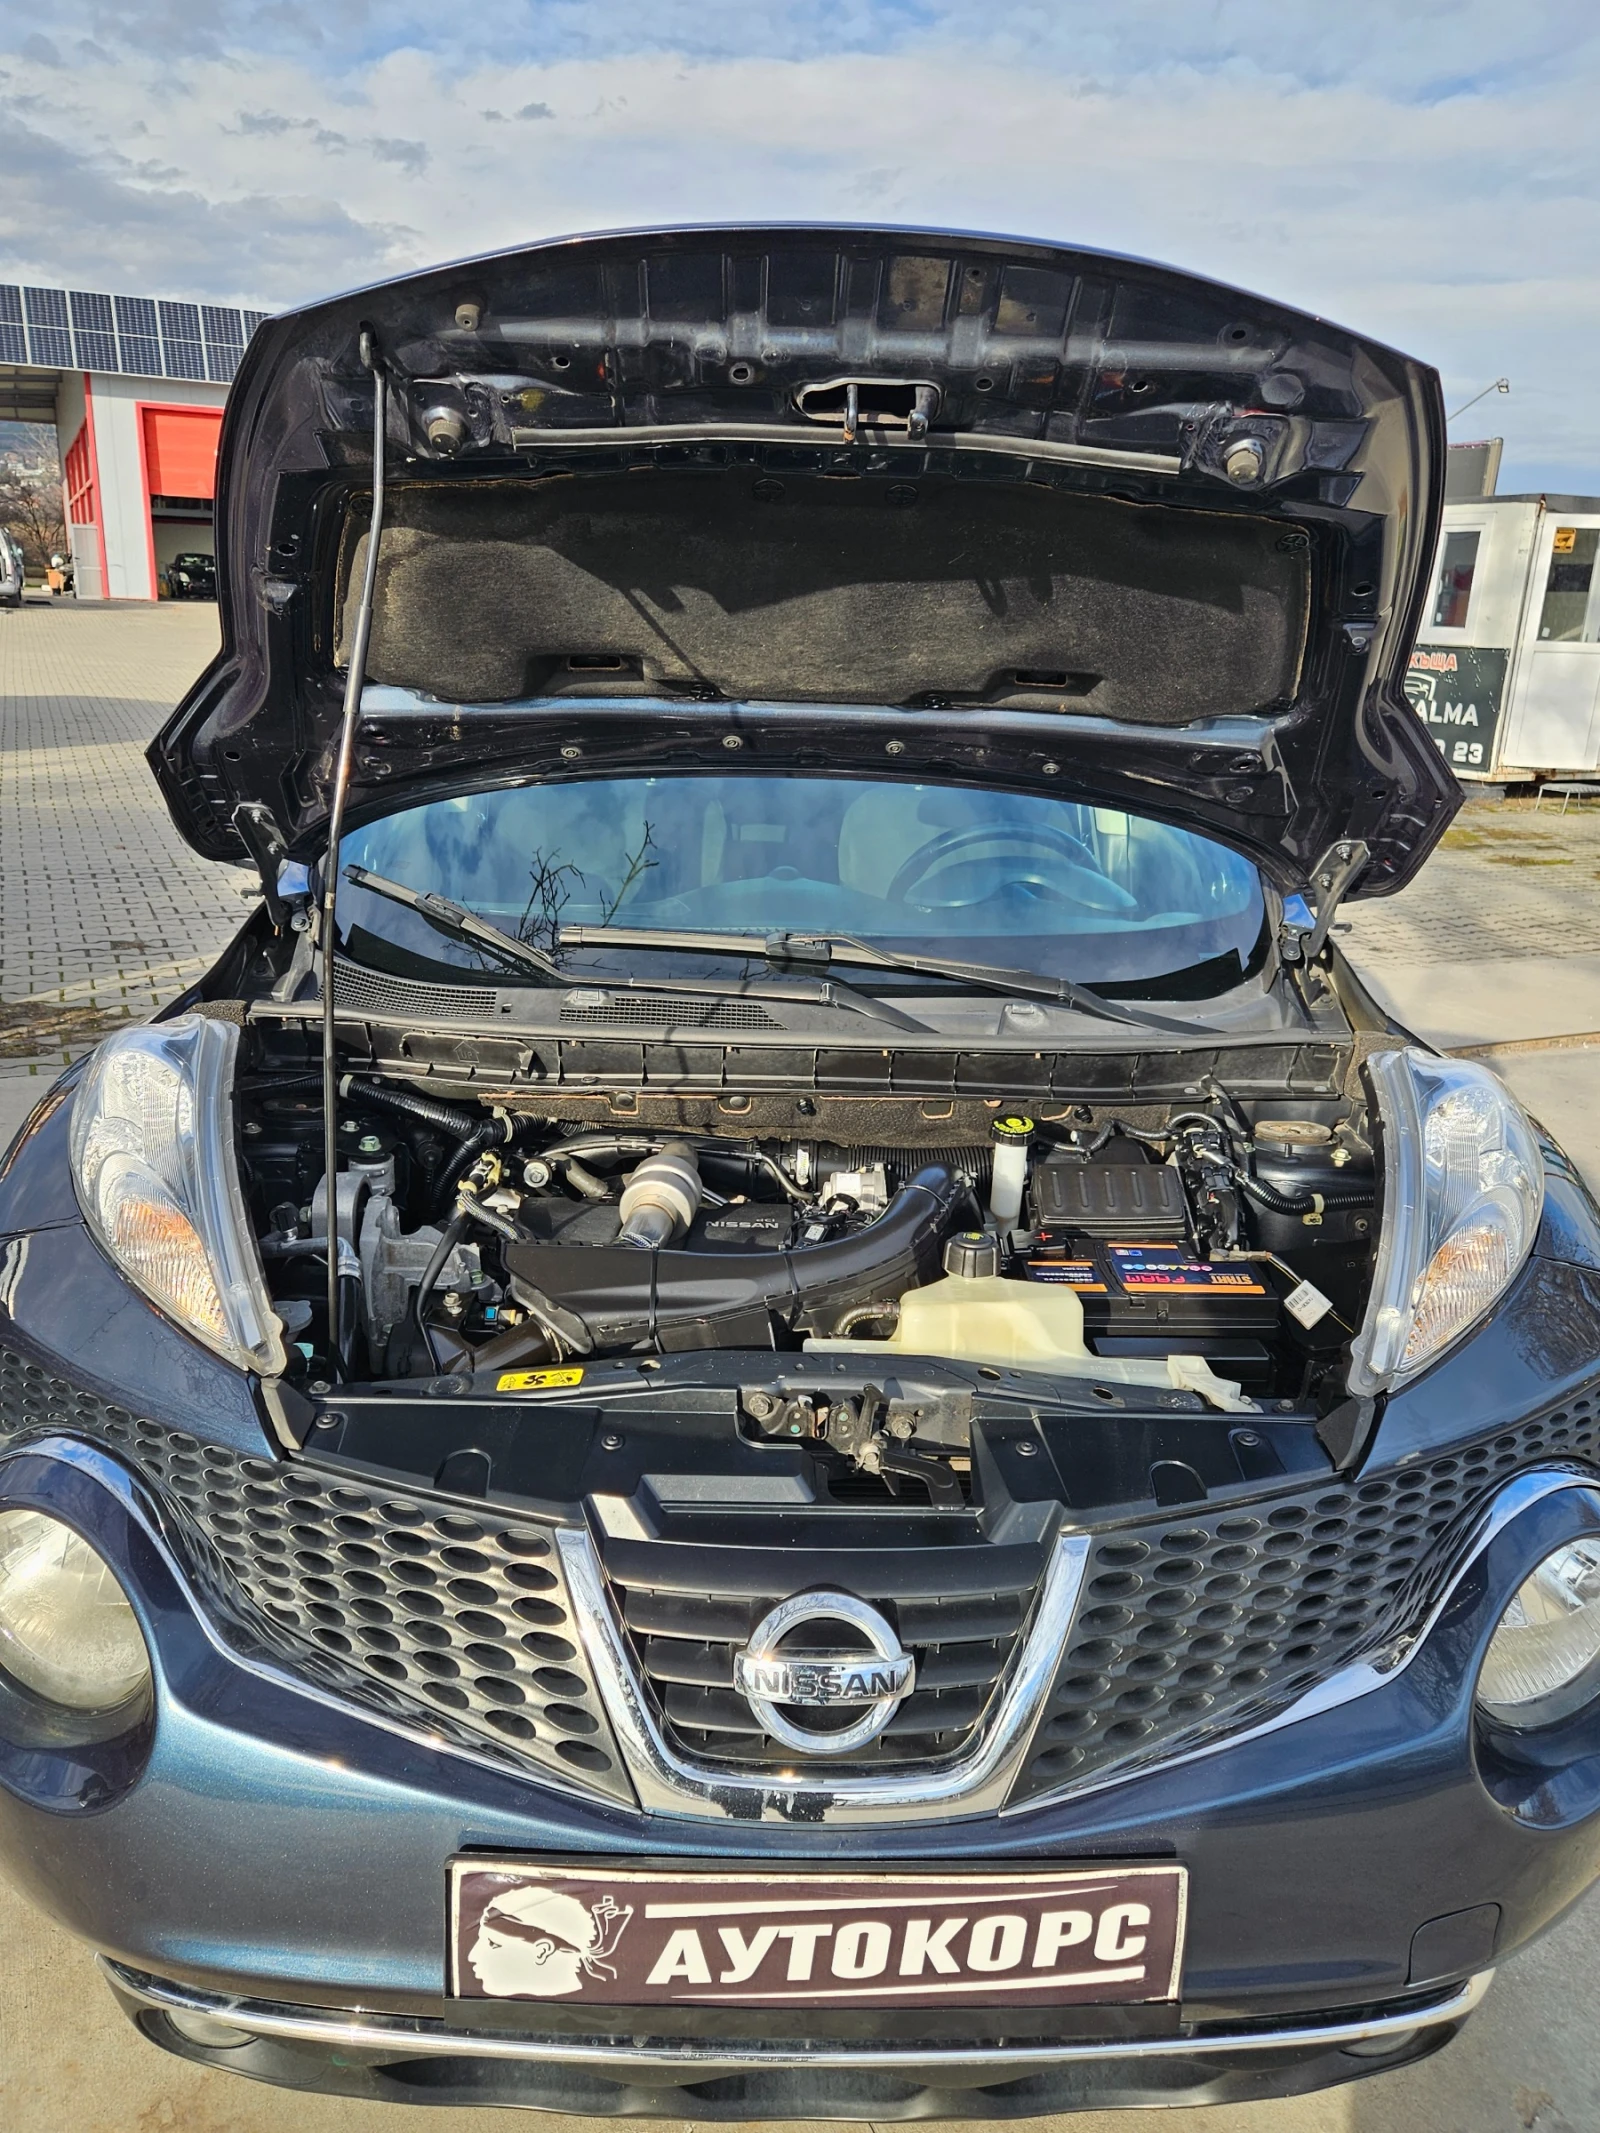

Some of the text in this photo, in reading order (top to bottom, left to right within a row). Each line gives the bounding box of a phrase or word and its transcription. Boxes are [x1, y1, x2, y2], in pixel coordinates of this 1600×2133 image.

[1409, 698, 1479, 727] ALMA
[1452, 741, 1484, 764] 23
[706, 1221, 779, 1229] NISSAN
[1210, 1274, 1253, 1285] START
[754, 1669, 897, 1698] NISSAN
[645, 1903, 1151, 1984] АУТОКОРС
